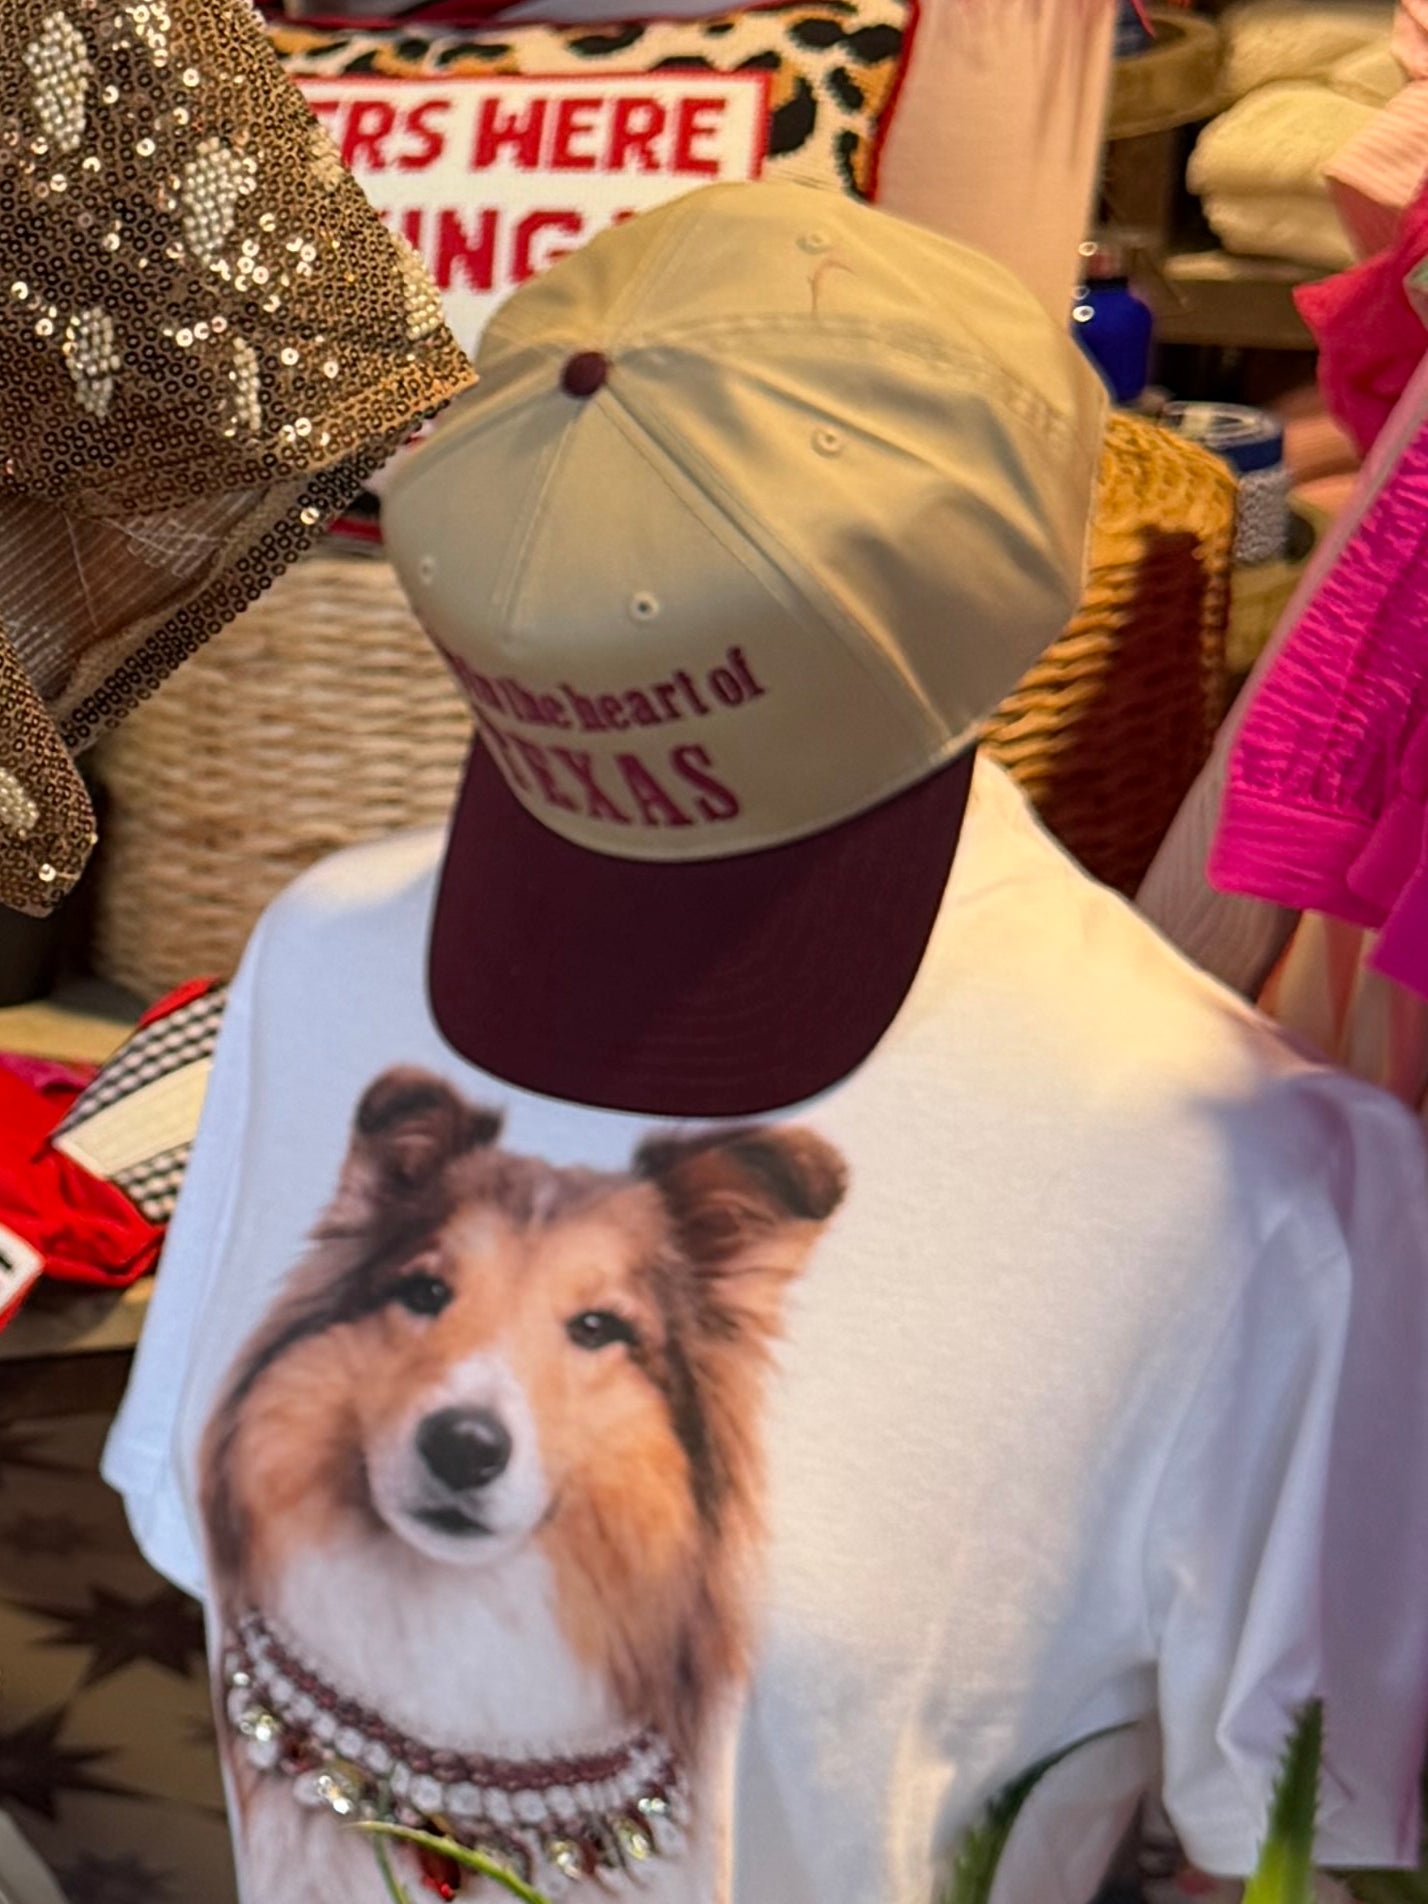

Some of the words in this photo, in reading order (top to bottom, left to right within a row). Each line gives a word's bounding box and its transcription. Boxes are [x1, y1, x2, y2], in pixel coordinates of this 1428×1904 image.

[470, 98, 727, 174] WERE
[560, 668, 711, 732] heart
[707, 645, 766, 708] of
